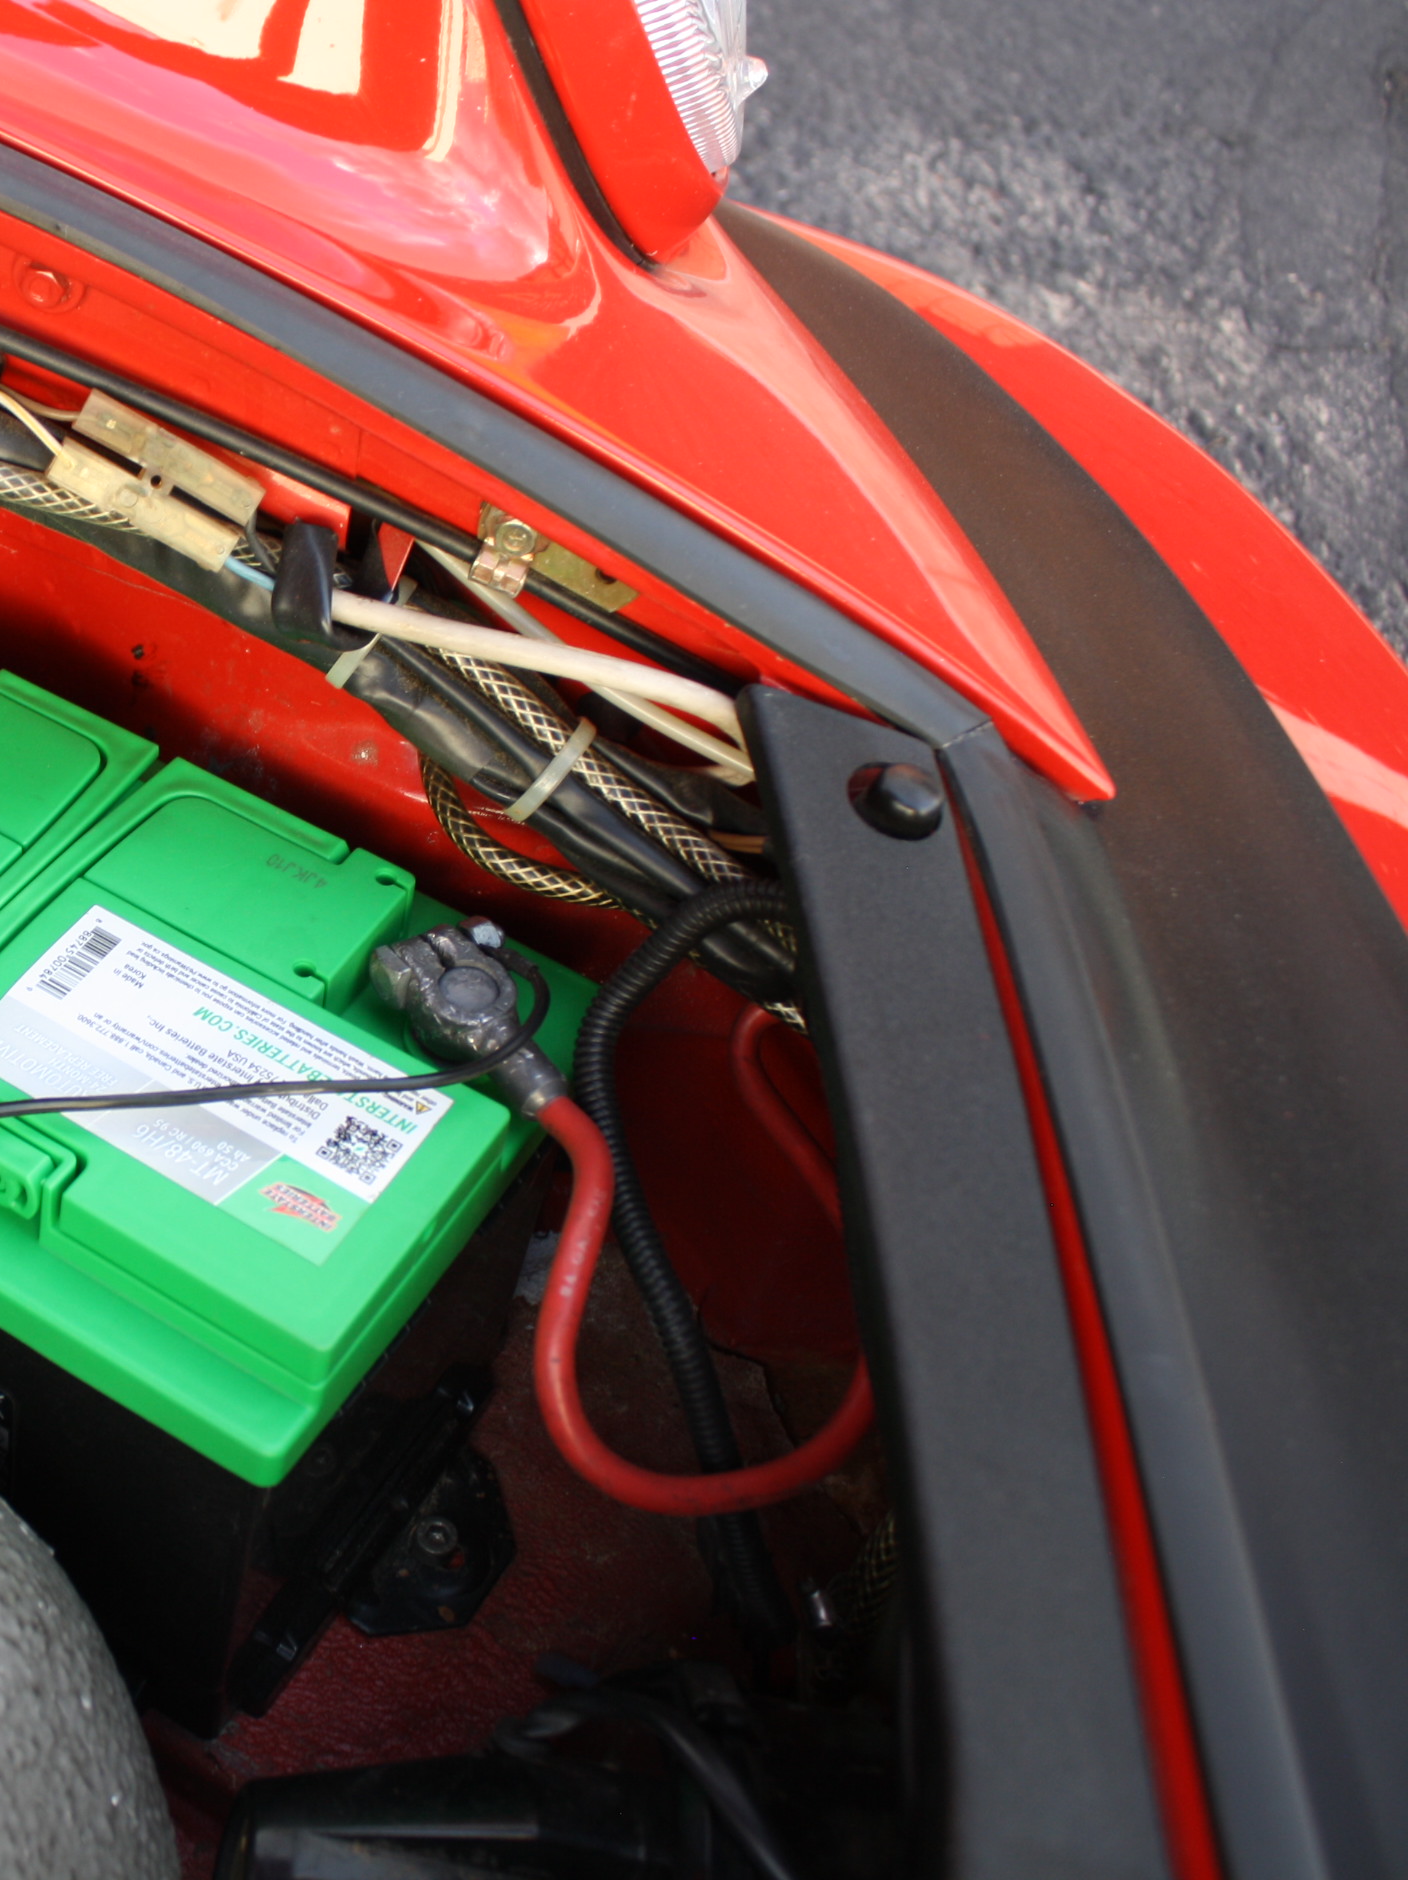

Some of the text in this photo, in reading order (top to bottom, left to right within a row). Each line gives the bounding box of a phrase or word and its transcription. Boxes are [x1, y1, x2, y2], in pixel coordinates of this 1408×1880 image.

[63, 929, 92, 955] 88745
[38, 954, 67, 980] 00784
[121, 962, 148, 980] Korea
[119, 971, 145, 989] Made
[128, 1043, 145, 1055] call
[162, 1026, 209, 1057] Batteries
[12, 1021, 118, 1087] FREE REPLACEMENT
[223, 1048, 249, 1067] USA
[170, 1066, 187, 1079] and
[191, 1003, 418, 1136] INTERSTEBATTERIES.COM
[205, 1050, 255, 1083] Interstate
[239, 1106, 263, 1122] under
[265, 1110, 293, 1129] limited
[275, 1104, 313, 1128] Interstate
[260, 1117, 289, 1137] replace
[286, 1132, 299, 1143] To
[290, 1124, 306, 1136] For
[130, 1121, 230, 1187] MT-48/H6
[151, 1116, 240, 1172] CCA 690 RC 95
[215, 1139, 252, 1164] Ah 50
